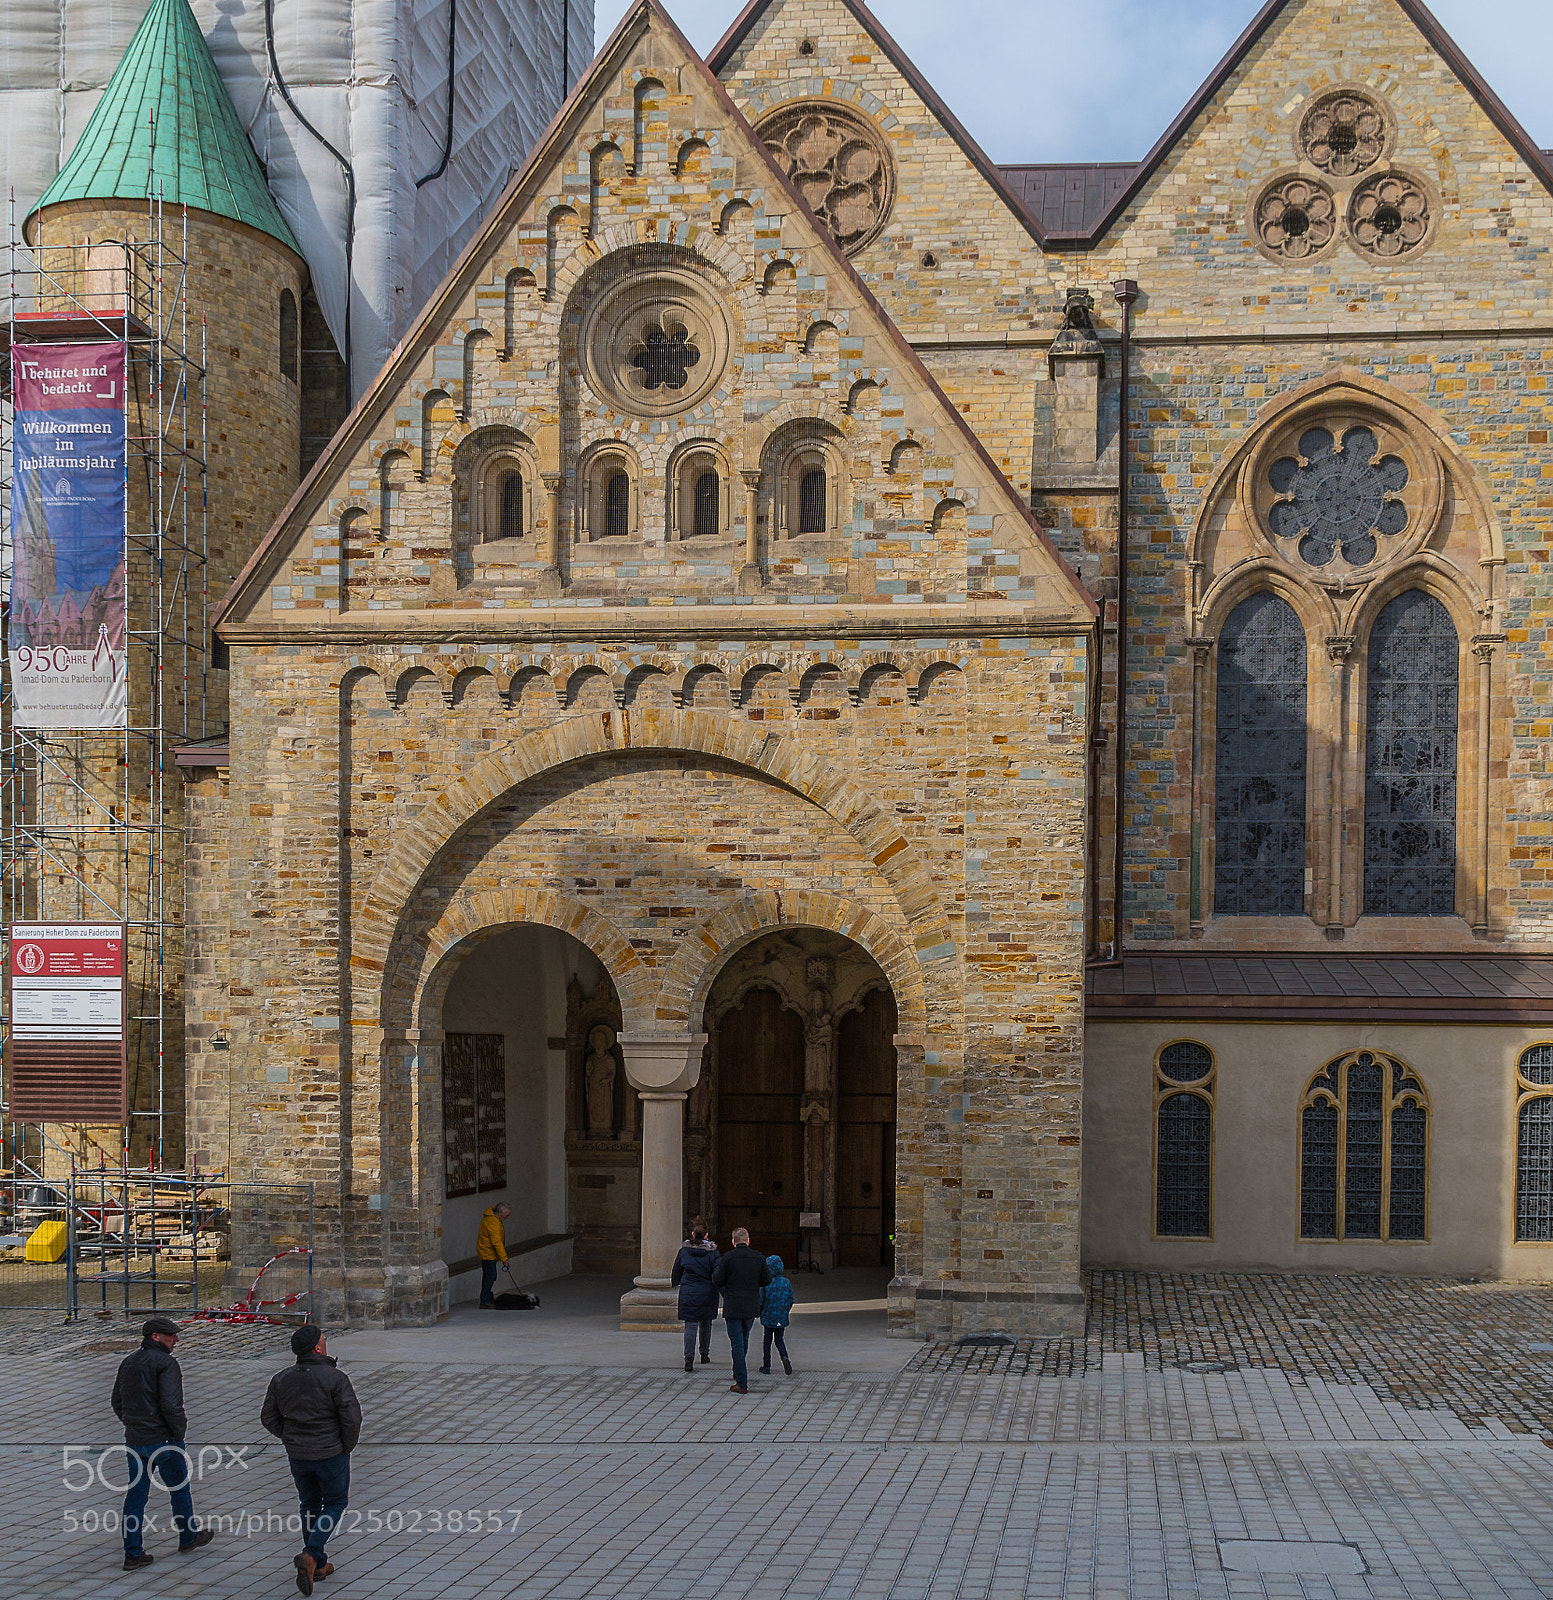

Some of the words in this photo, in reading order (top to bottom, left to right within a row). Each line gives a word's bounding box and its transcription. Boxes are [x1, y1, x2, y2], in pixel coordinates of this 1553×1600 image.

[30, 367, 79, 379] behütet
[82, 365, 107, 377] und
[42, 382, 92, 395] bedacht
[22, 422, 112, 435] Willkommen
[55, 438, 74, 451] im
[18, 455, 117, 472] Jubiläumsjahr
[18, 646, 69, 672] 950
[63, 655, 87, 666] JAHRE
[61, 676, 70, 684] zu
[71, 674, 112, 684] Paderborn
[14, 929, 45, 938] Sanierung
[46, 929, 64, 937] Hoher
[65, 929, 79, 937] Dom
[88, 929, 120, 937] Paderborn
